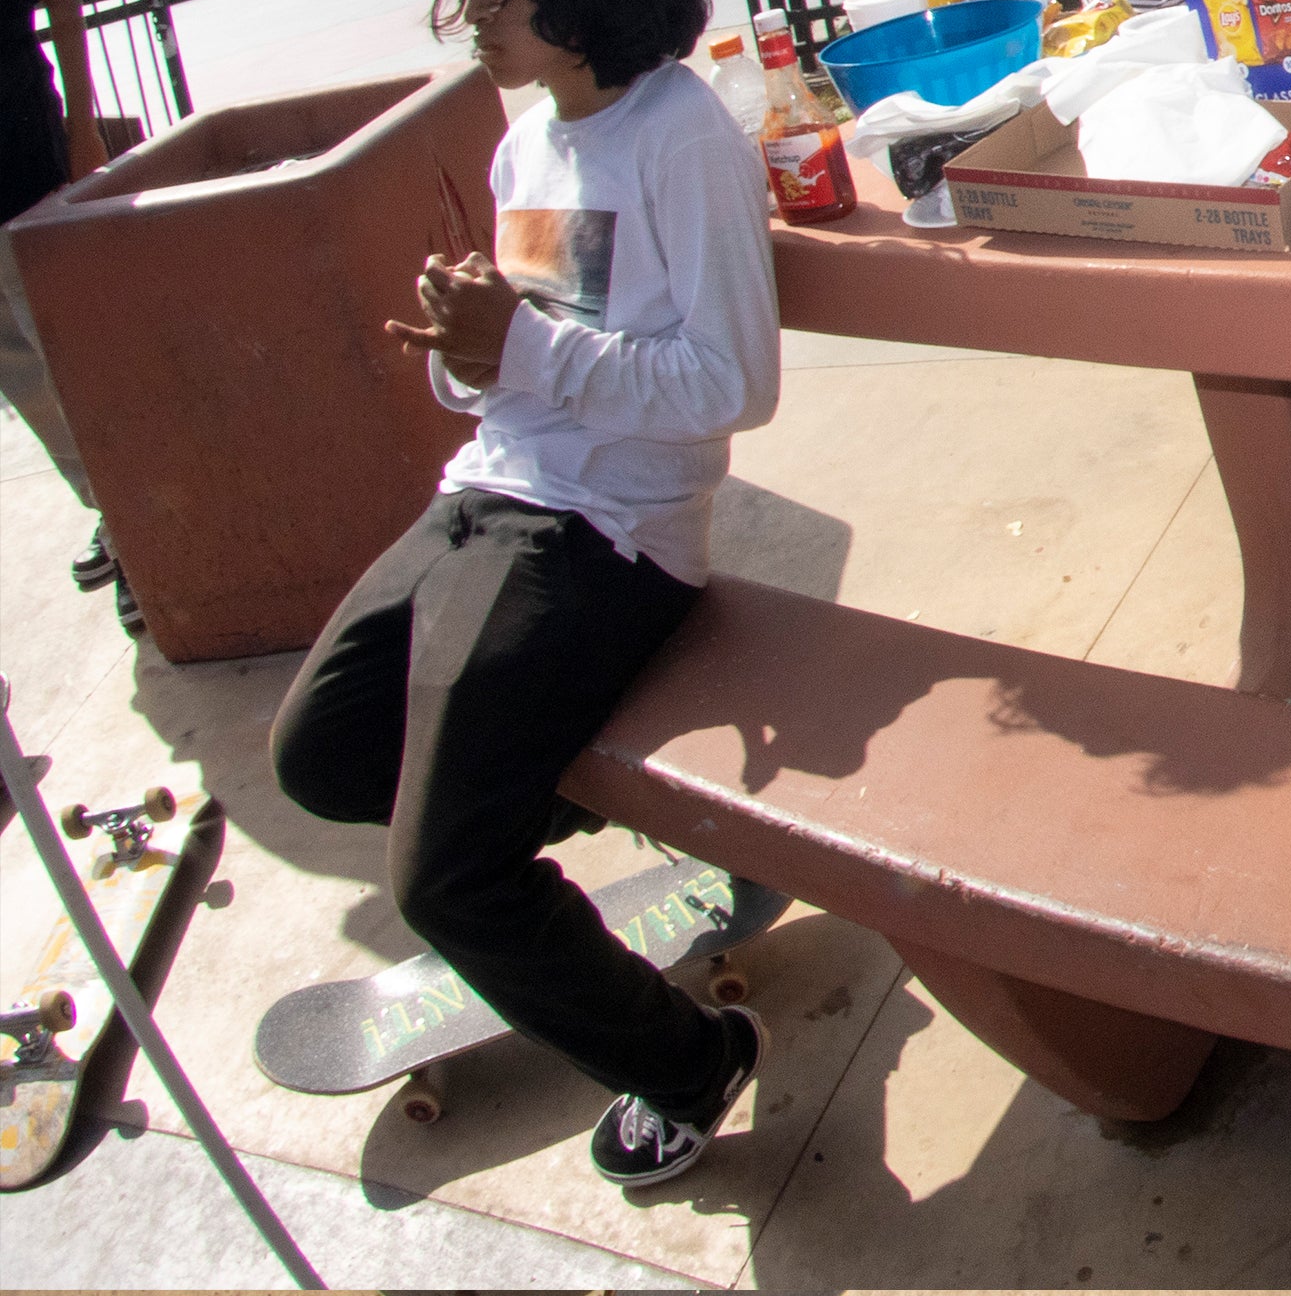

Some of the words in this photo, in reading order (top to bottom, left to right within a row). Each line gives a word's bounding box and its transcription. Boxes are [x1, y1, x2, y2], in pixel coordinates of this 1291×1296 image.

[1219, 10, 1242, 27] Lay's
[957, 189, 979, 203] 2-28
[980, 191, 1018, 207] BOTTLE
[962, 206, 993, 220] TRAYS
[1194, 208, 1221, 224] 2-28
[1224, 210, 1269, 228] BOTTLE
[1232, 227, 1271, 245] TRAYS
